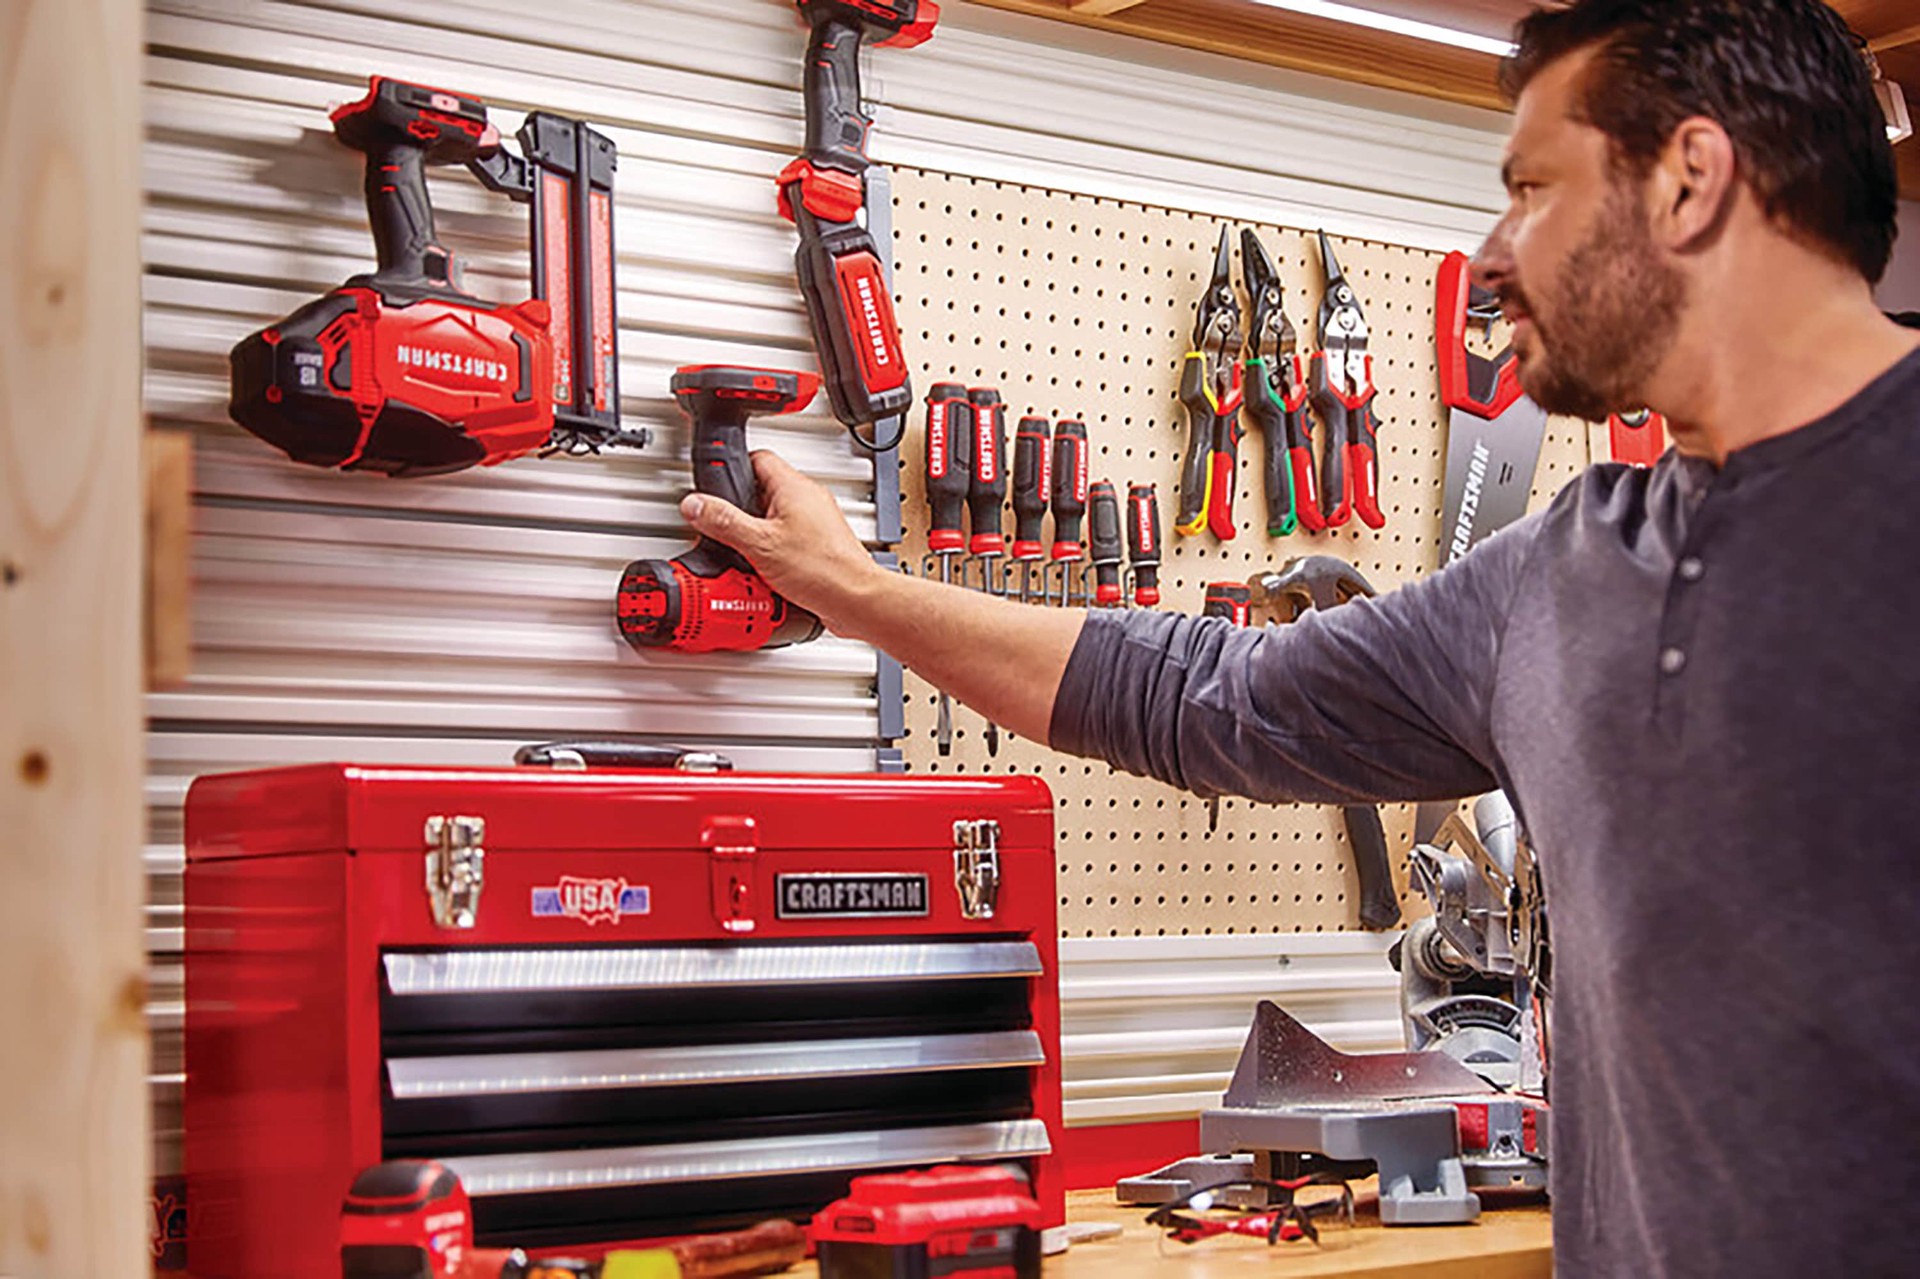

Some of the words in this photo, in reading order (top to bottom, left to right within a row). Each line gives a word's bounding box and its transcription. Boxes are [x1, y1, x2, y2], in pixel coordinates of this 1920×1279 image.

[857, 277, 889, 365] CRAFTSMAN
[398, 345, 507, 381] CRAFTSMAN
[931, 404, 944, 475] CRAFTSMAN
[979, 409, 993, 480] CRAFTSMAN
[565, 884, 616, 912] USA
[787, 881, 921, 909] CRAFTSMAN
